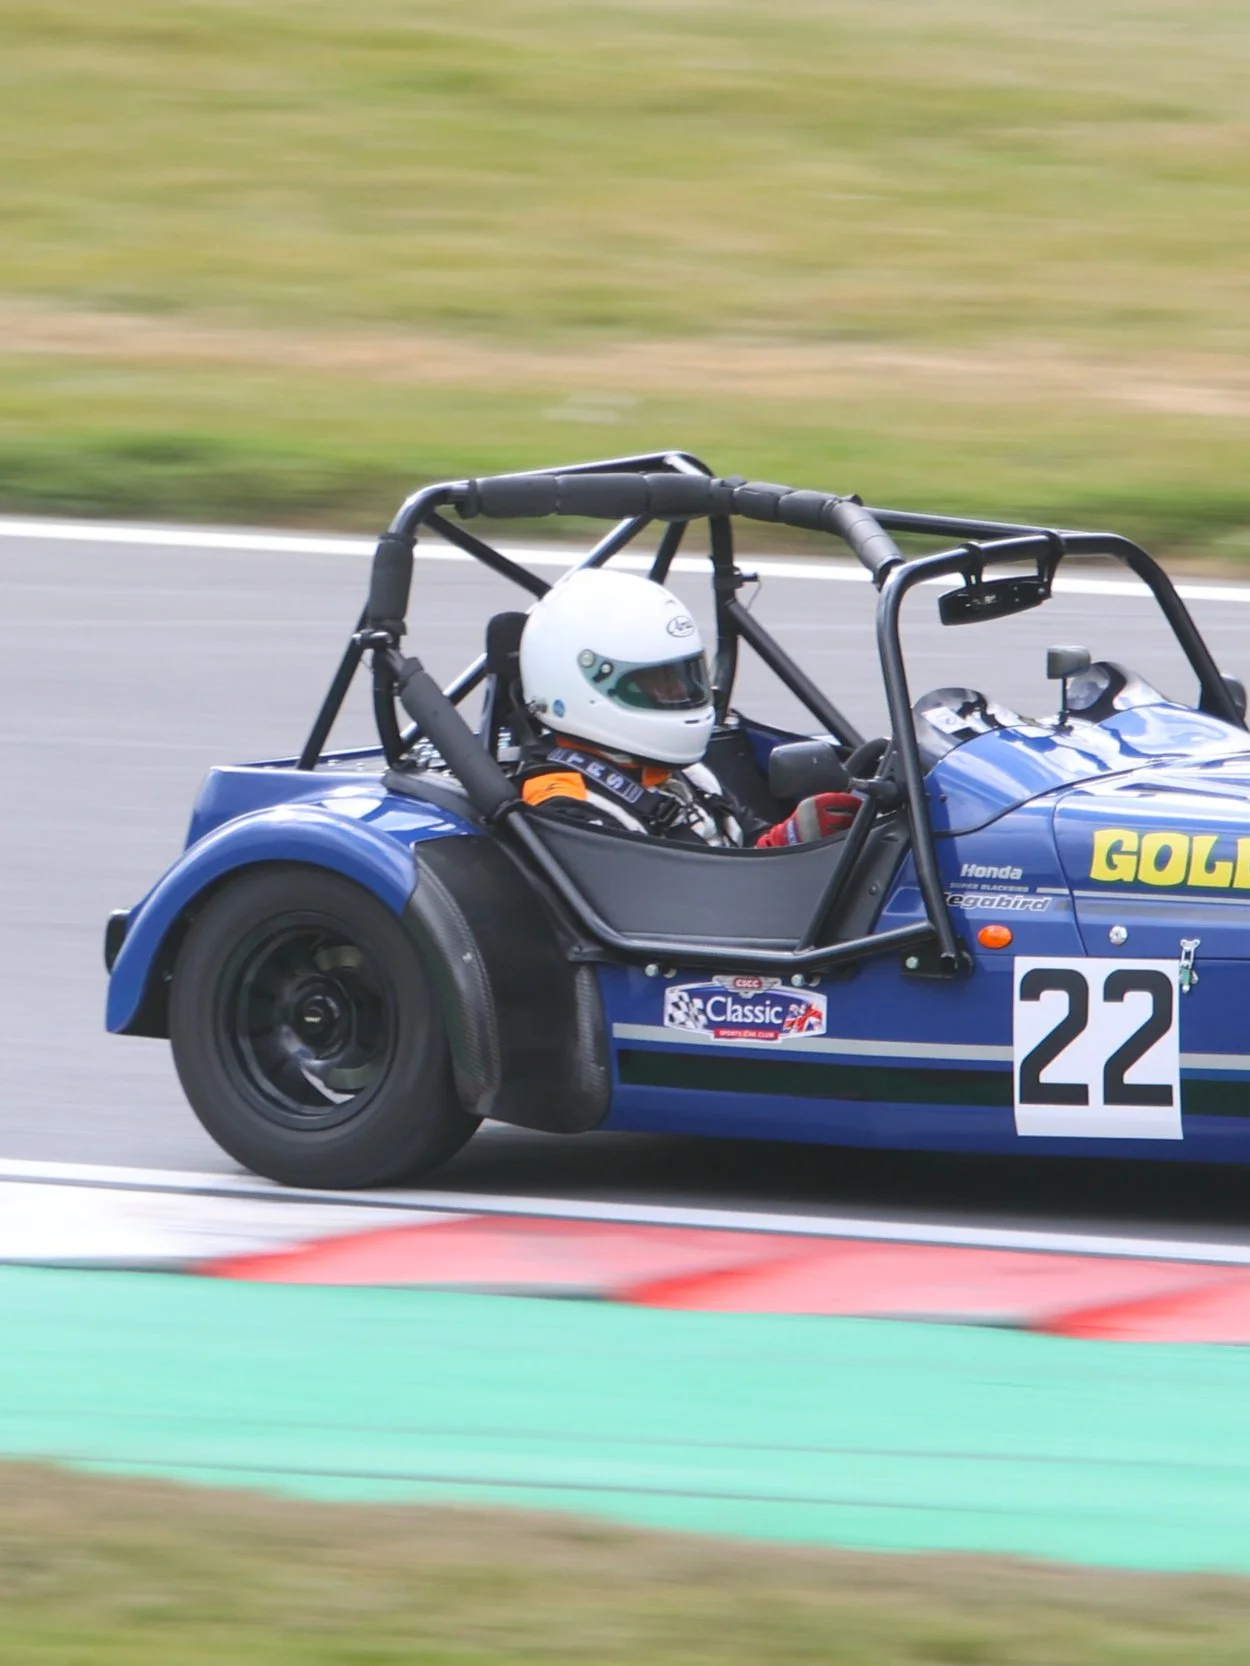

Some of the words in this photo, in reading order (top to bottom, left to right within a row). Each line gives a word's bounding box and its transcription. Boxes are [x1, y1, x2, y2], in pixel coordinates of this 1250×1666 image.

[566, 752, 624, 789] TRS
[960, 864, 1023, 880] Honda
[944, 892, 1052, 911] egabird
[705, 995, 783, 1024] Classic
[1019, 967, 1174, 1107] 22
